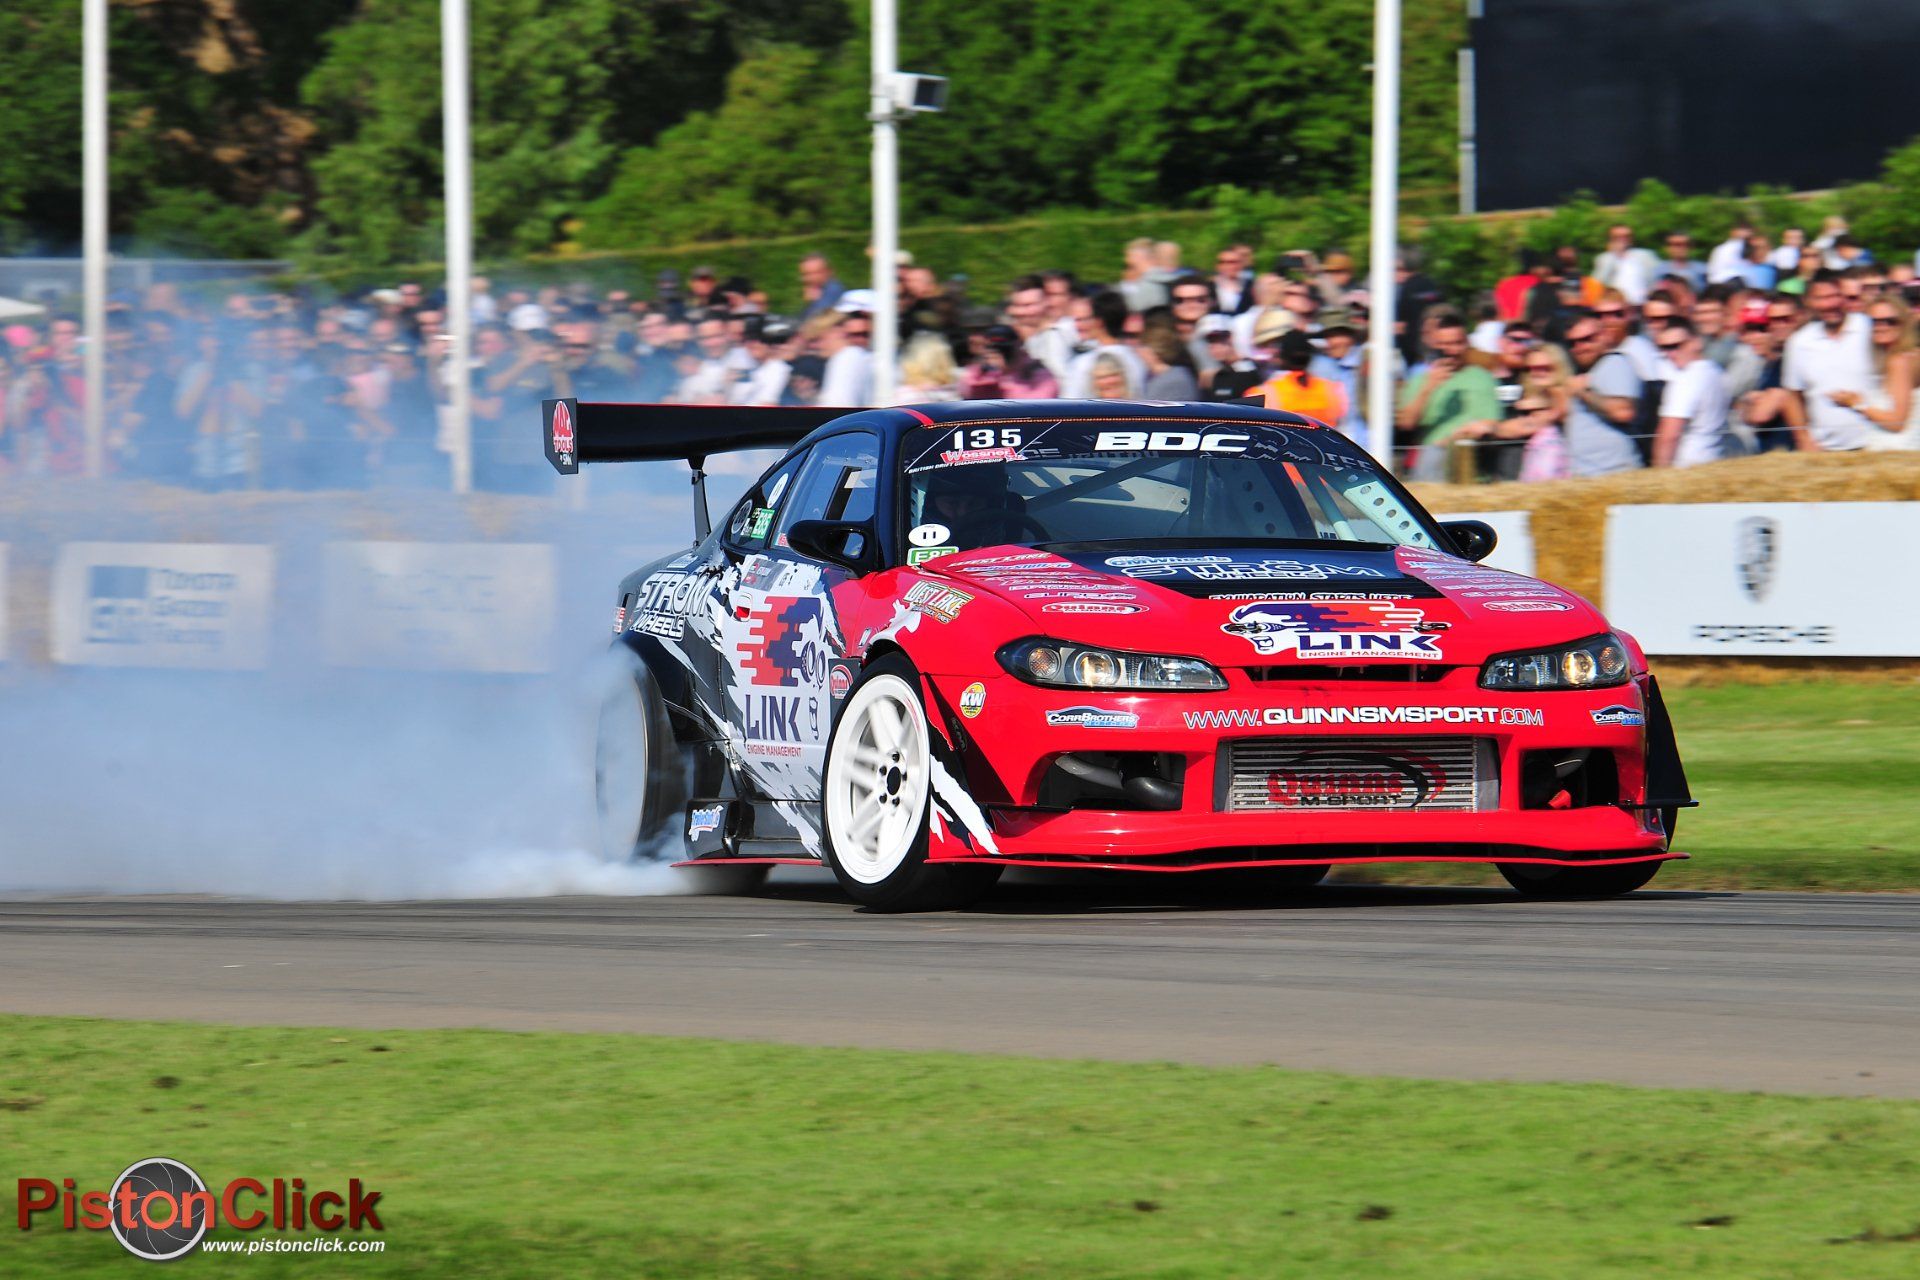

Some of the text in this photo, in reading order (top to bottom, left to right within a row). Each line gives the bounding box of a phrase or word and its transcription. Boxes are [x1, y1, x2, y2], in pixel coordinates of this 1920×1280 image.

[954, 429, 1022, 449] 135
[1094, 432, 1250, 452] BDC
[630, 611, 684, 638] WHEELS
[1298, 634, 1441, 651] LINK
[1351, 651, 1439, 659] MANAGEMENT
[960, 691, 985, 707] KW
[745, 694, 801, 741] LINK
[1048, 712, 1137, 723] CORRBROTHERS
[1183, 706, 1544, 729] WWW.QUINNSMSPORT.COM
[746, 744, 801, 758] ENGINE MANAGEMENT
